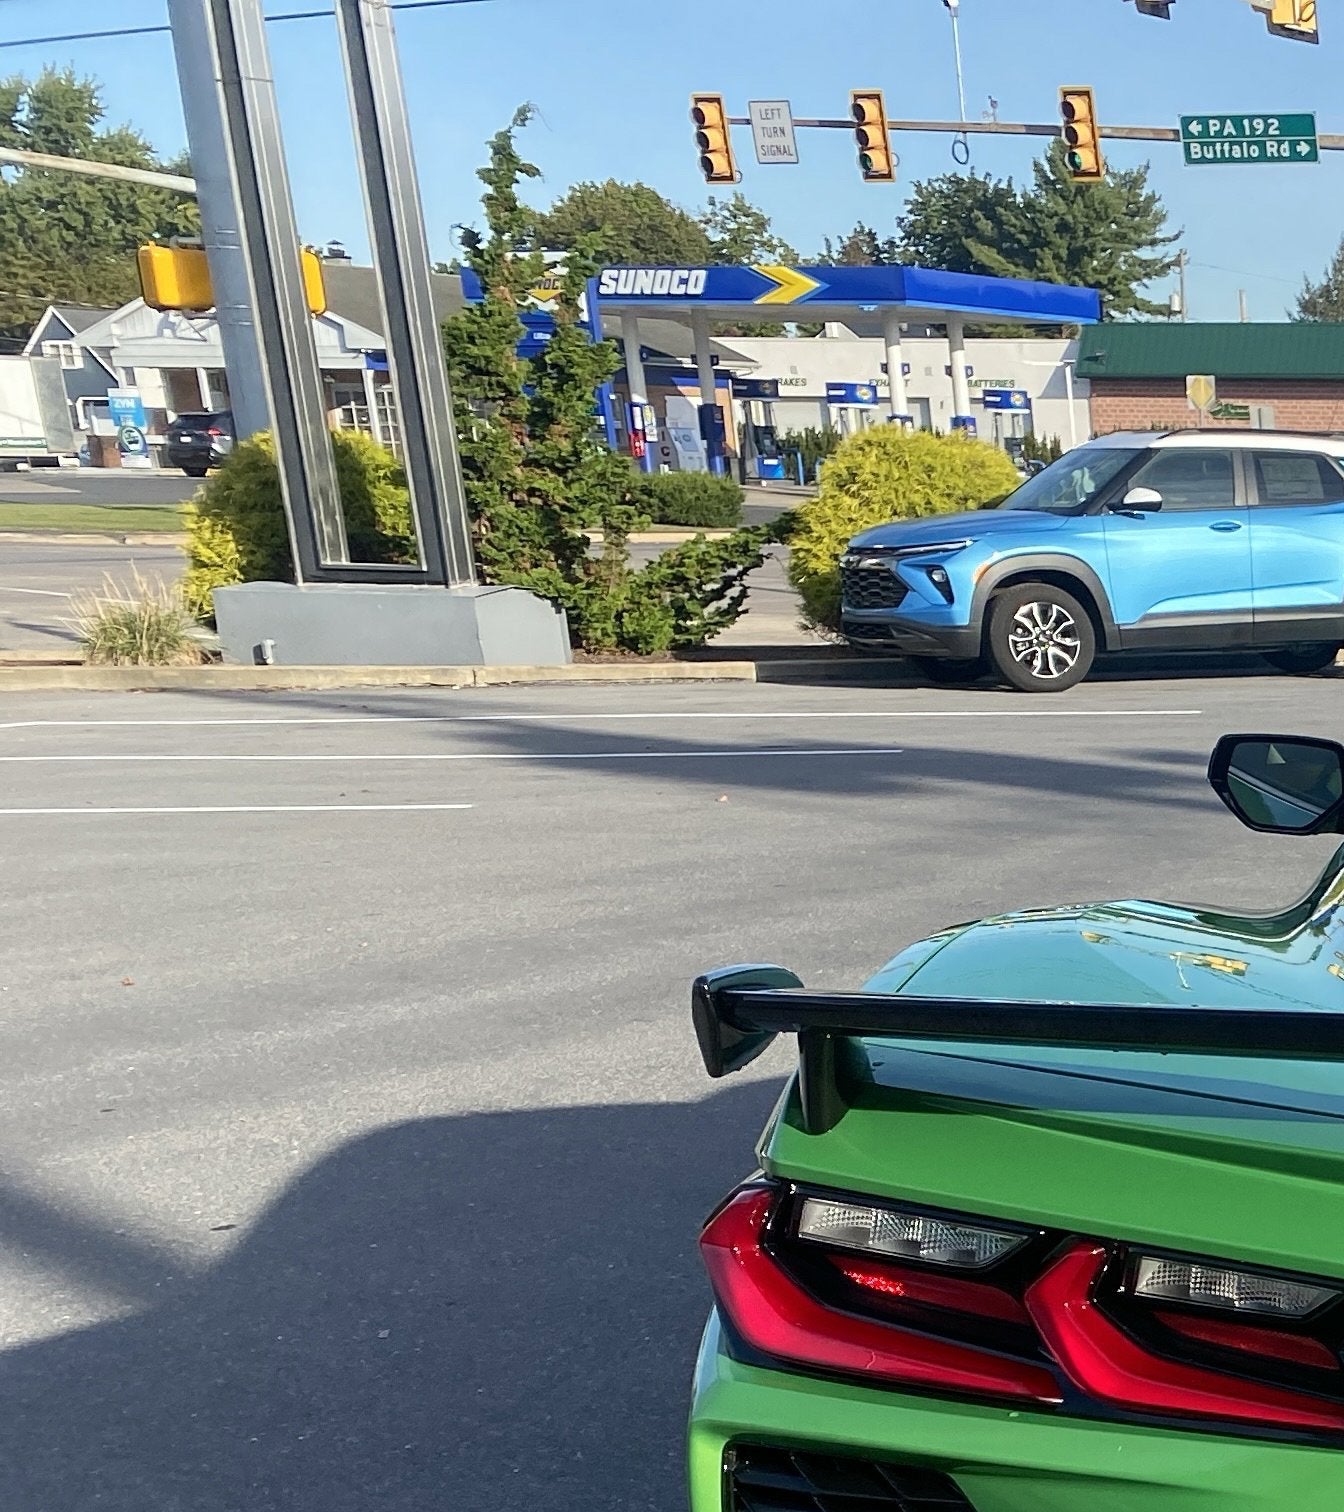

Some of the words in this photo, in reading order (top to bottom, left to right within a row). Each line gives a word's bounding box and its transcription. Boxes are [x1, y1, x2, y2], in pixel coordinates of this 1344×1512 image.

[759, 107, 782, 120] LEFT
[761, 126, 787, 138] TURN
[1208, 119, 1237, 136] PA
[1242, 118, 1280, 136] 192
[760, 144, 794, 157] SIGNAL
[1190, 141, 1260, 159] Buffalo
[1265, 140, 1290, 157] Rd
[599, 269, 708, 295] SUNOCO
[778, 377, 807, 387] RAKES
[967, 379, 1015, 388] BATTERIES
